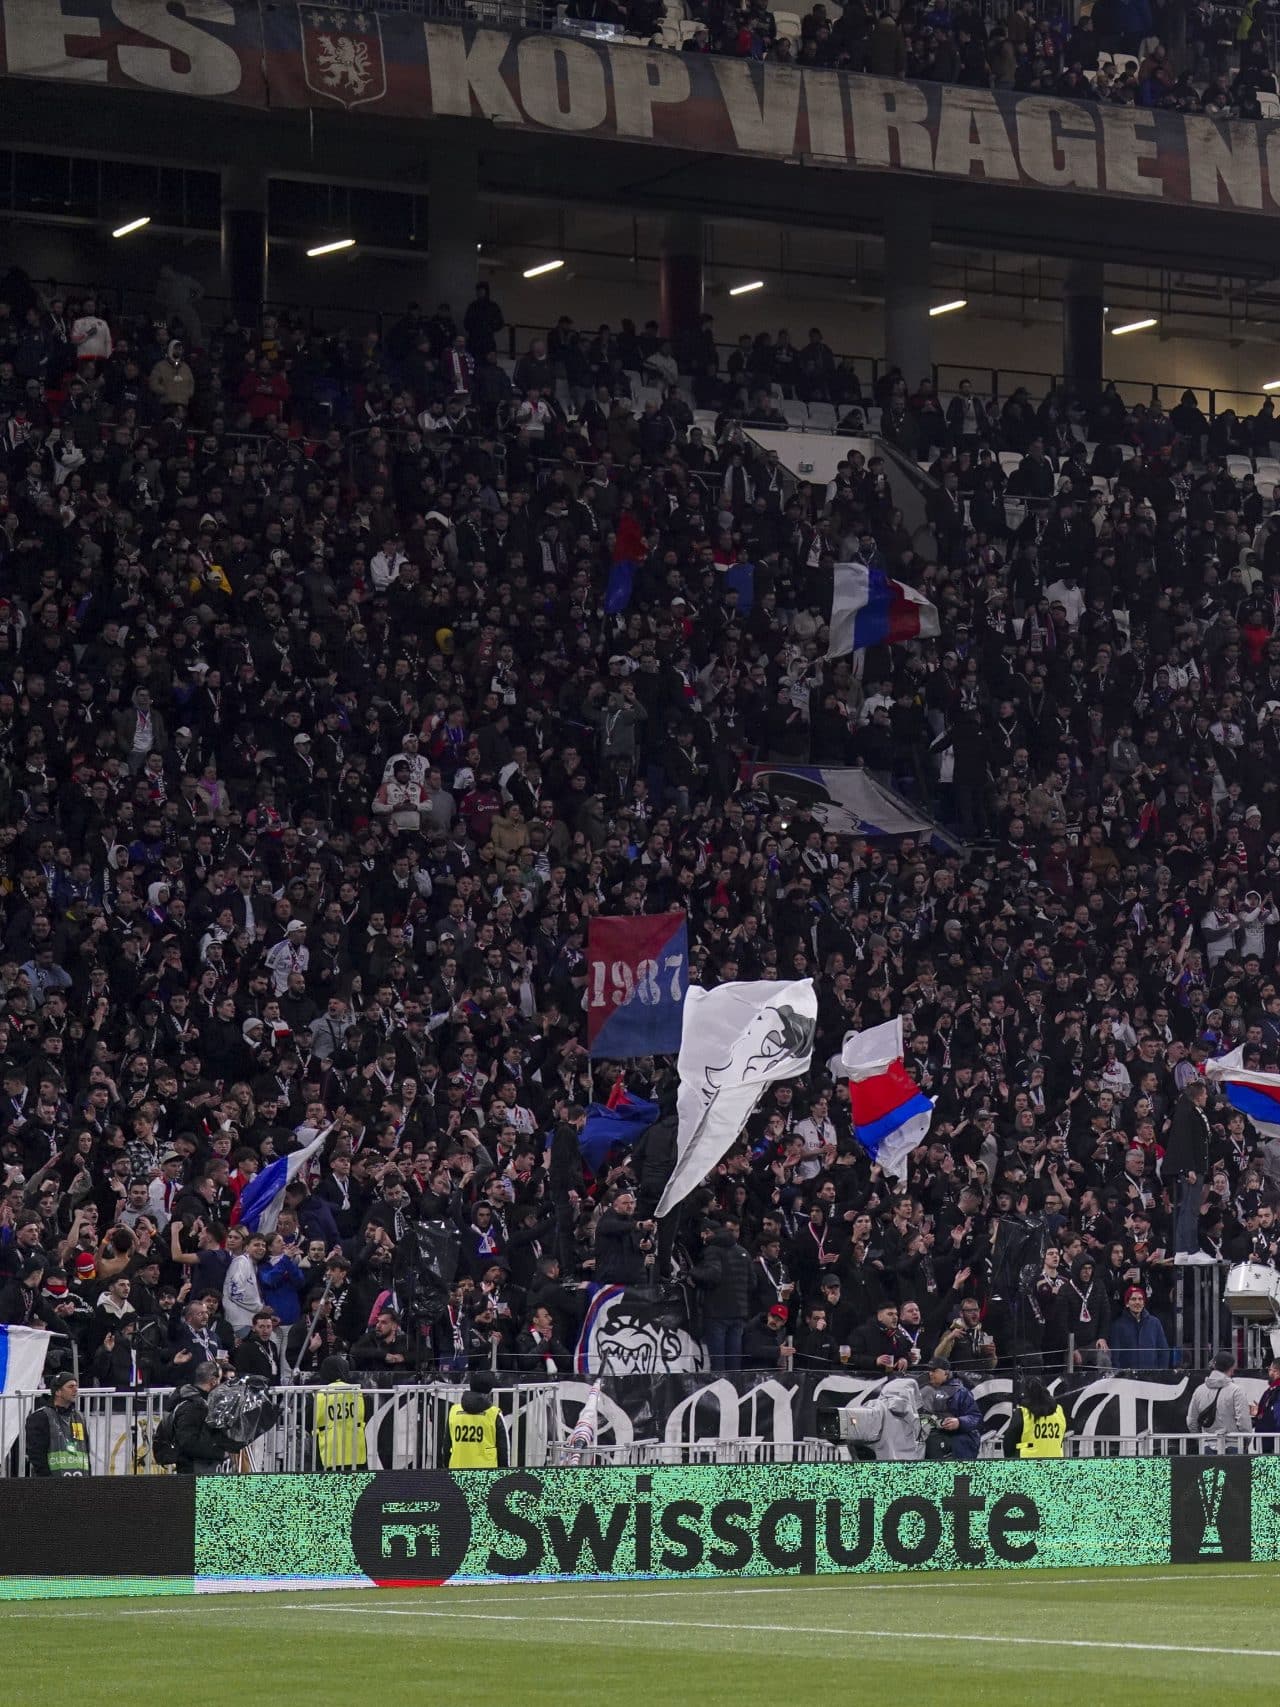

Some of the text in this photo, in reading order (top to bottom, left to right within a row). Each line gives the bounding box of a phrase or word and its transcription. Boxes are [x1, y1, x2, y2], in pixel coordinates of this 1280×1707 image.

[424, 22, 691, 138] KOP
[714, 60, 1164, 197] VIRAGE
[591, 954, 683, 1007] 1987
[454, 1425, 484, 1443] 0229
[1034, 1422, 1060, 1440] 0232
[487, 1474, 1038, 1575] Swissquote
